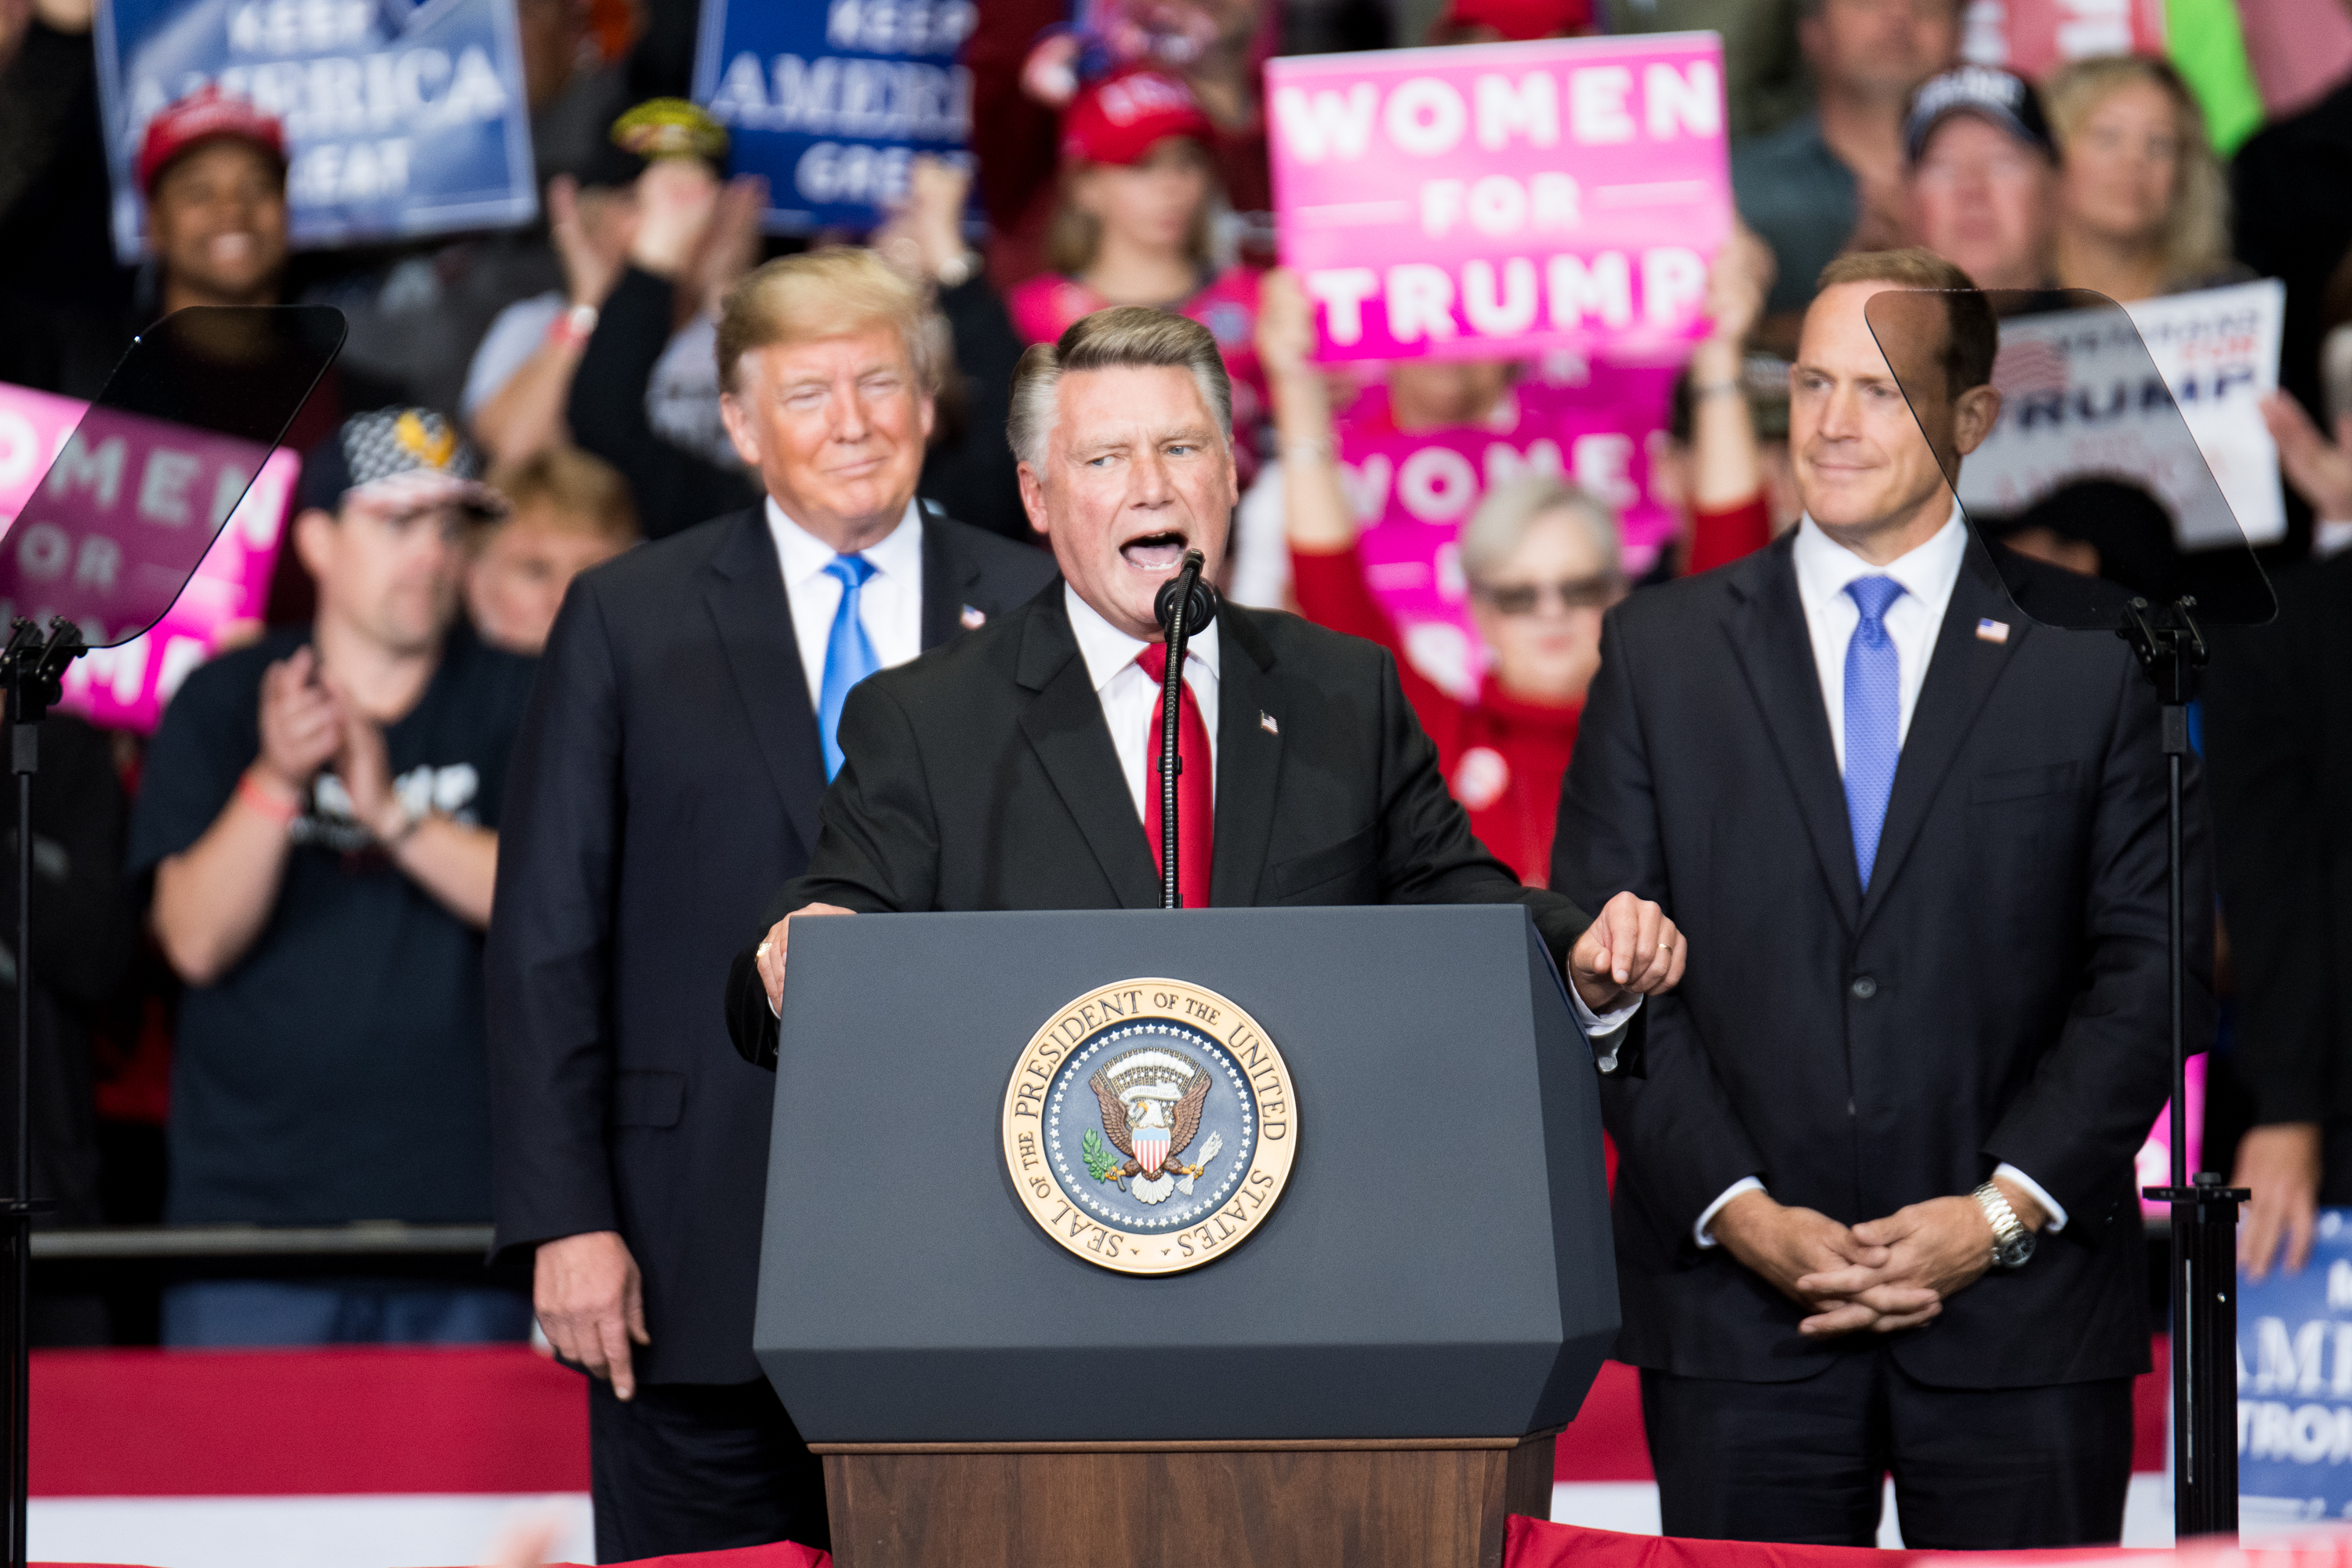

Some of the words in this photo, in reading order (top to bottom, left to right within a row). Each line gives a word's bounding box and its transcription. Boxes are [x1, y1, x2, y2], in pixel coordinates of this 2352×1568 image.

[1272, 60, 1722, 163] WOMEN
[1419, 171, 1582, 237] FOR
[1306, 245, 1709, 347] TRUMP
[0, 409, 287, 547] OMEN
[1153, 992, 1179, 1010] OF
[1185, 996, 1221, 1026] THE
[1014, 989, 1143, 1120] PRESIDENT
[1228, 1022, 1287, 1142] UNITED
[1127, 1087, 1159, 1096] PLURIBUS
[1018, 1131, 1040, 1171] THE
[1029, 1175, 1051, 1200] OF
[1177, 1168, 1275, 1258] STATES
[1051, 1198, 1124, 1258] SEAL
